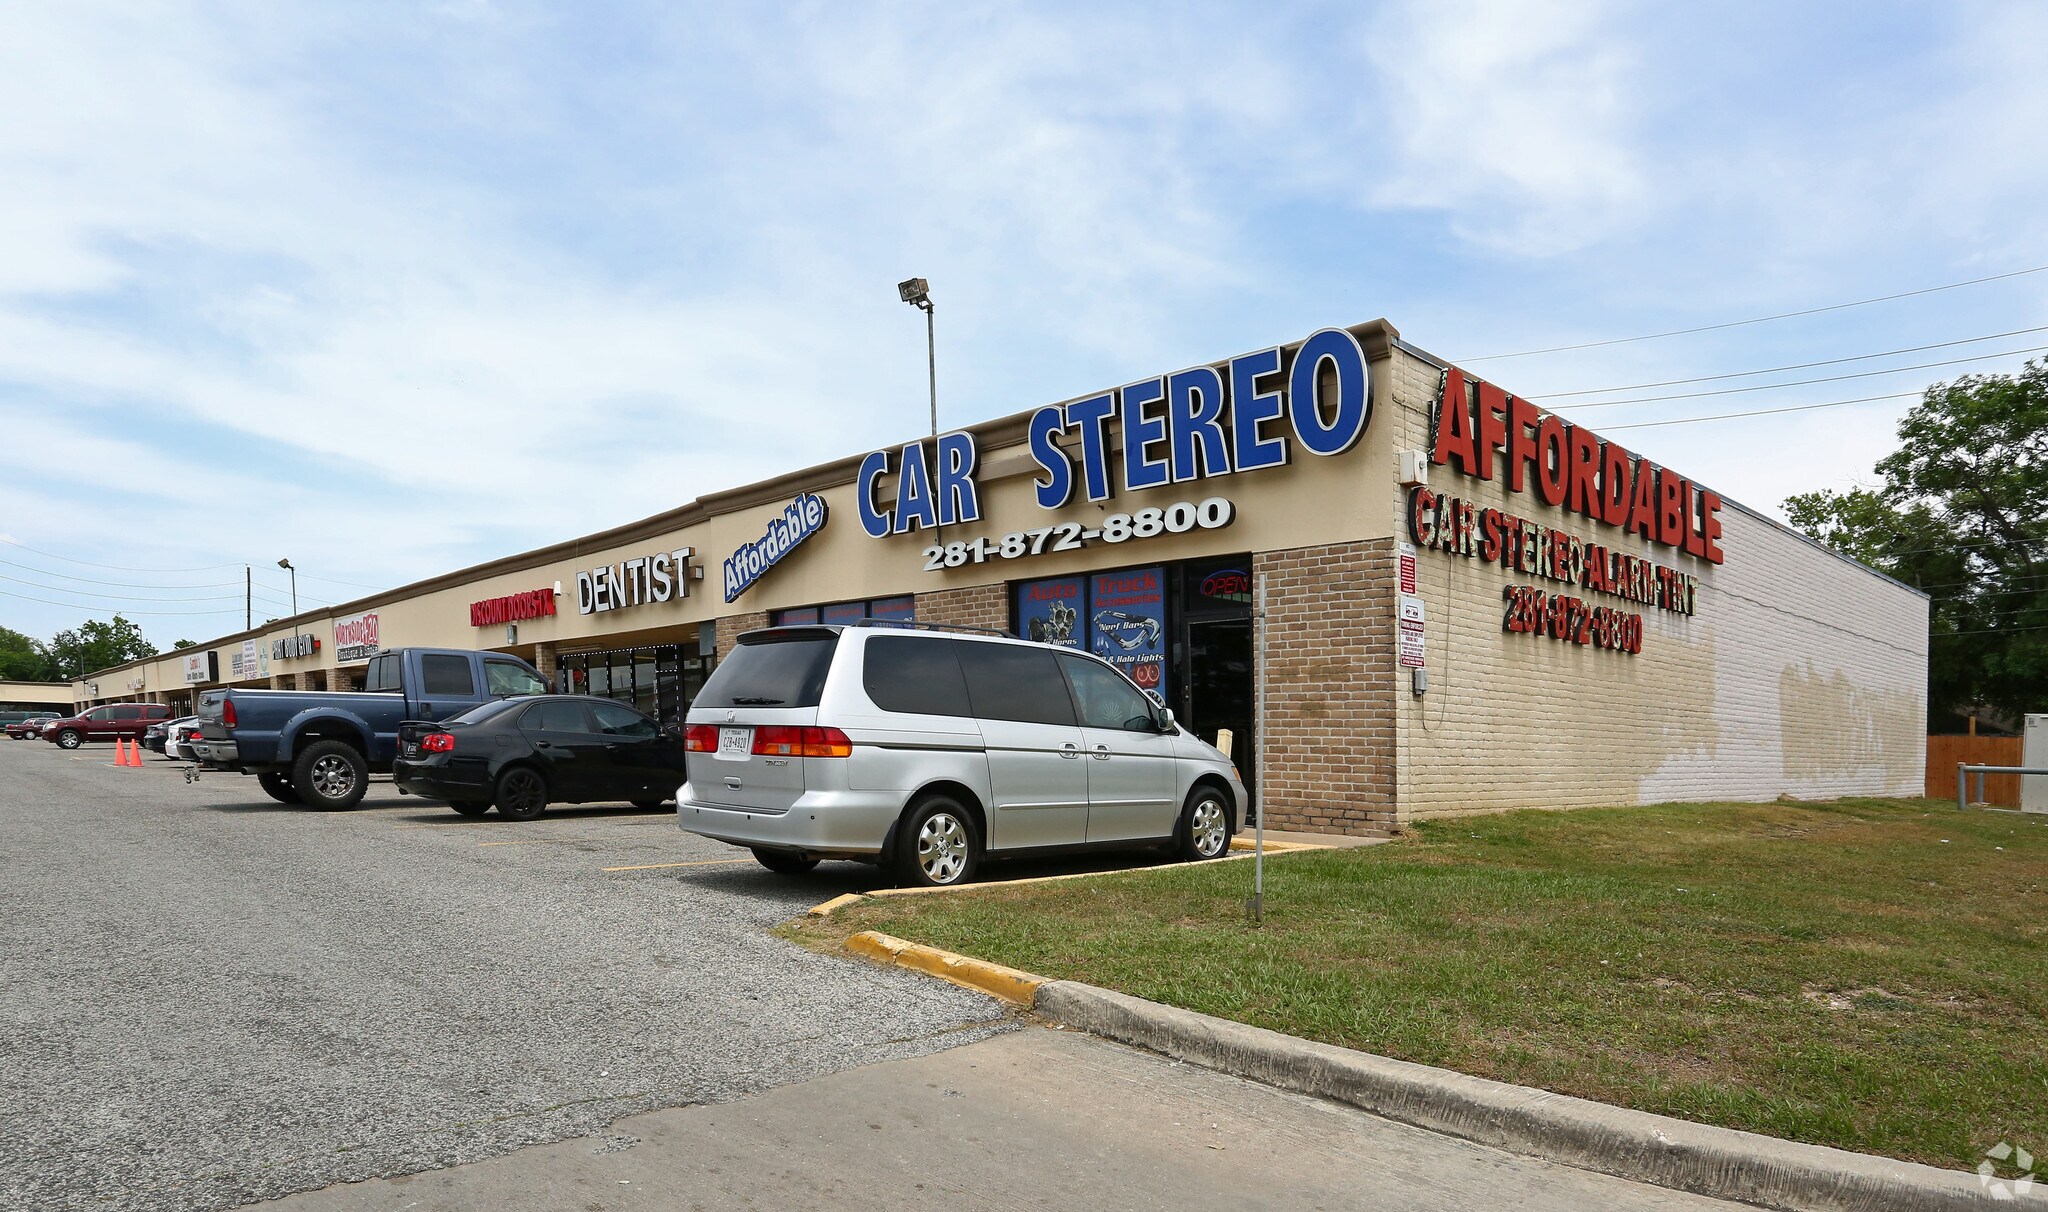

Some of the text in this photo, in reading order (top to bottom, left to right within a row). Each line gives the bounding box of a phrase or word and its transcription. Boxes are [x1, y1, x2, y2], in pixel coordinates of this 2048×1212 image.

[857, 327, 1371, 538] CAR STEREO
[1430, 368, 1724, 565] AFFORDABLE
[922, 497, 1234, 572] 281-872-8800
[1408, 486, 1478, 557] CAR
[724, 494, 826, 602] Affordable
[576, 547, 696, 615] DENTIST
[1027, 581, 1077, 602] Auto
[1093, 593, 1161, 608] Accessories
[1096, 571, 1158, 595] Truck
[1201, 575, 1249, 596] OPEN
[470, 597, 507, 627] DISCOUNT
[1099, 621, 1145, 633] Nerf Bars
[1502, 584, 1643, 654] 281-872-8800
[1117, 655, 1136, 664] Halo
[1137, 653, 1165, 665] Lights
